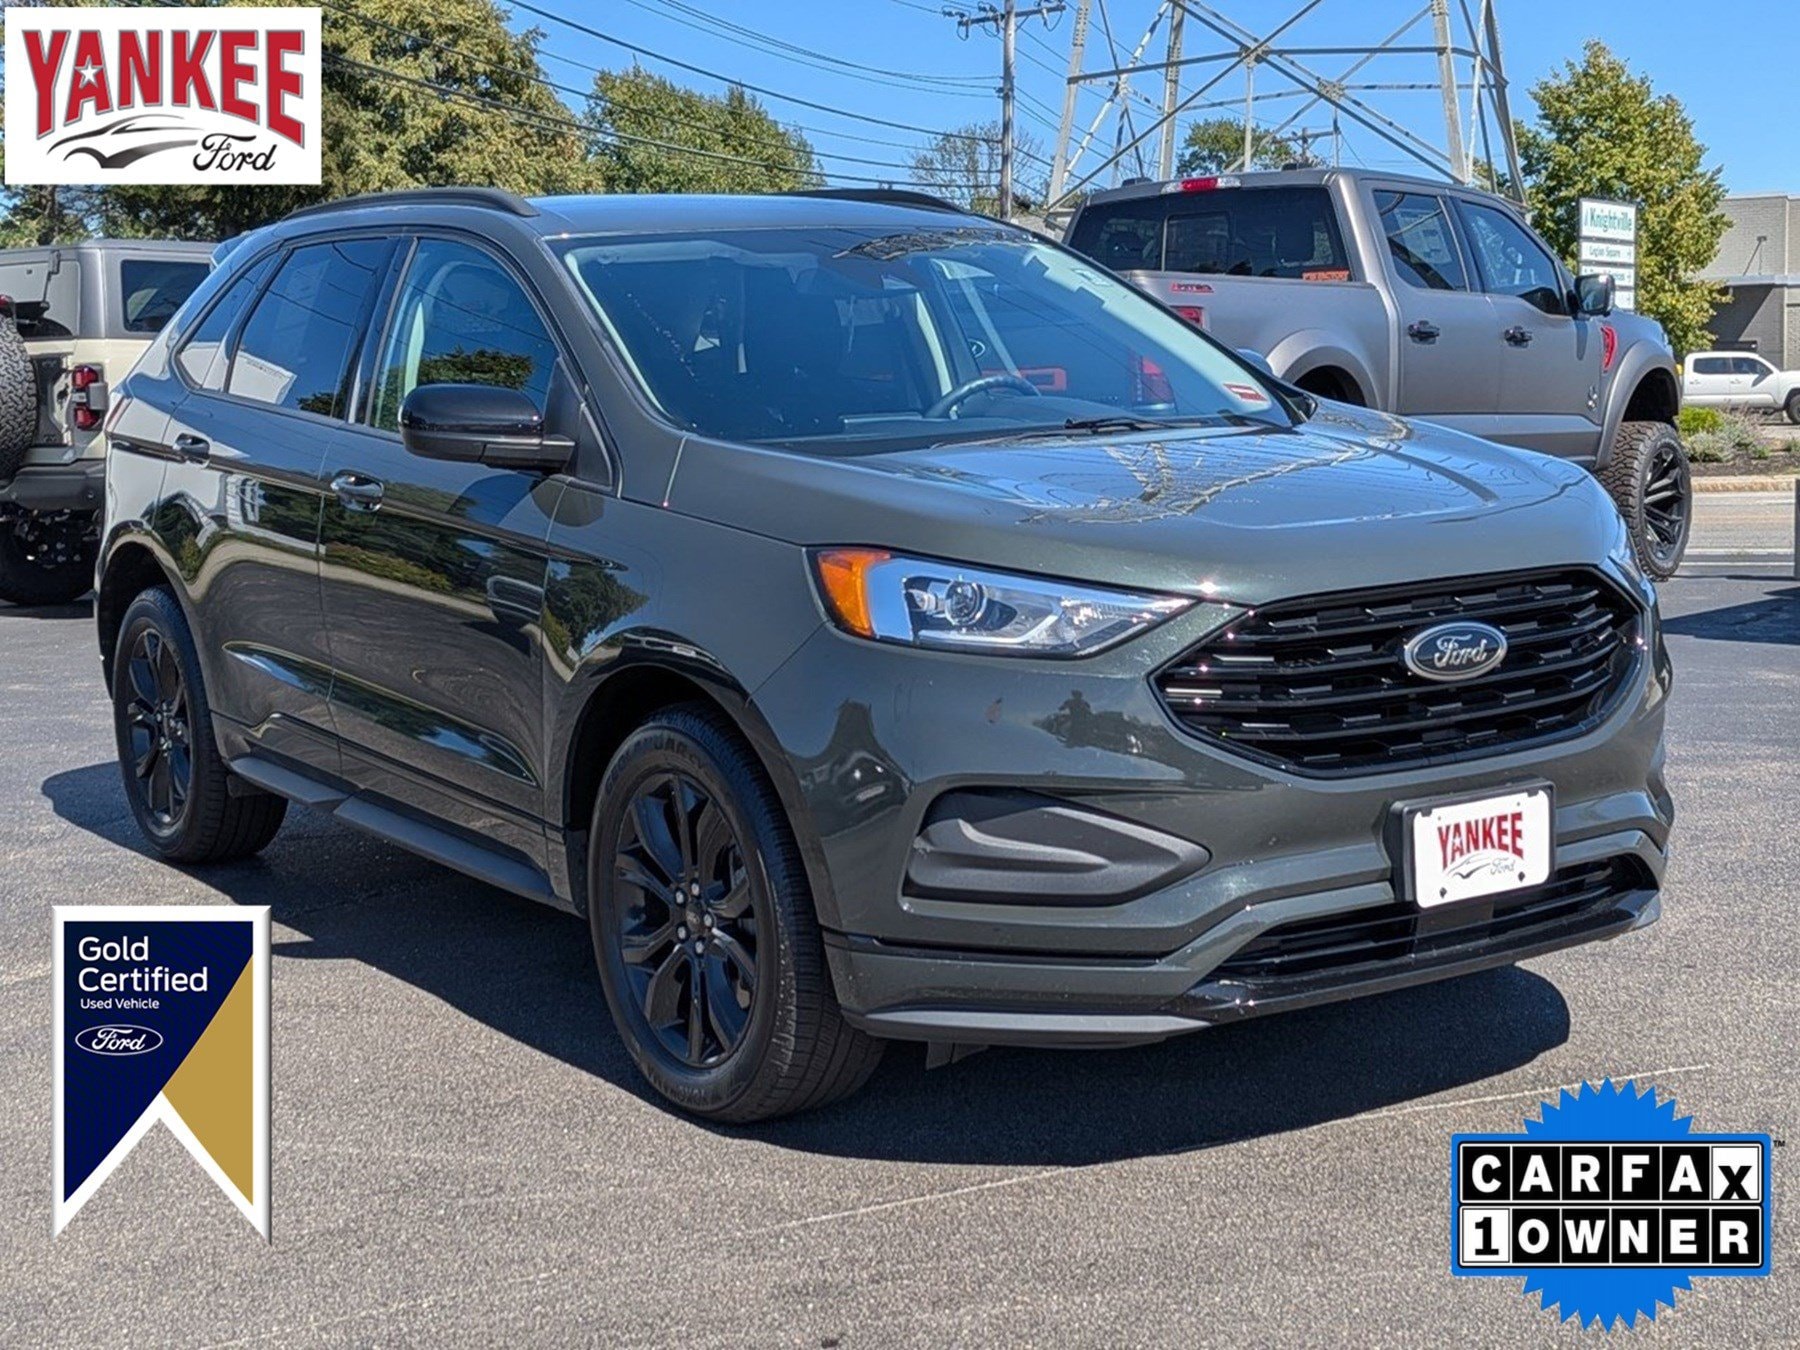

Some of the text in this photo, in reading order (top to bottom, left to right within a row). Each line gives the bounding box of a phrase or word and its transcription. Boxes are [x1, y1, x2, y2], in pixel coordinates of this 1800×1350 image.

[1589, 207, 1632, 233] Knightville
[1434, 634, 1488, 668] Ford
[1437, 811, 1524, 872] YANKEE
[1490, 857, 1516, 875] Ford
